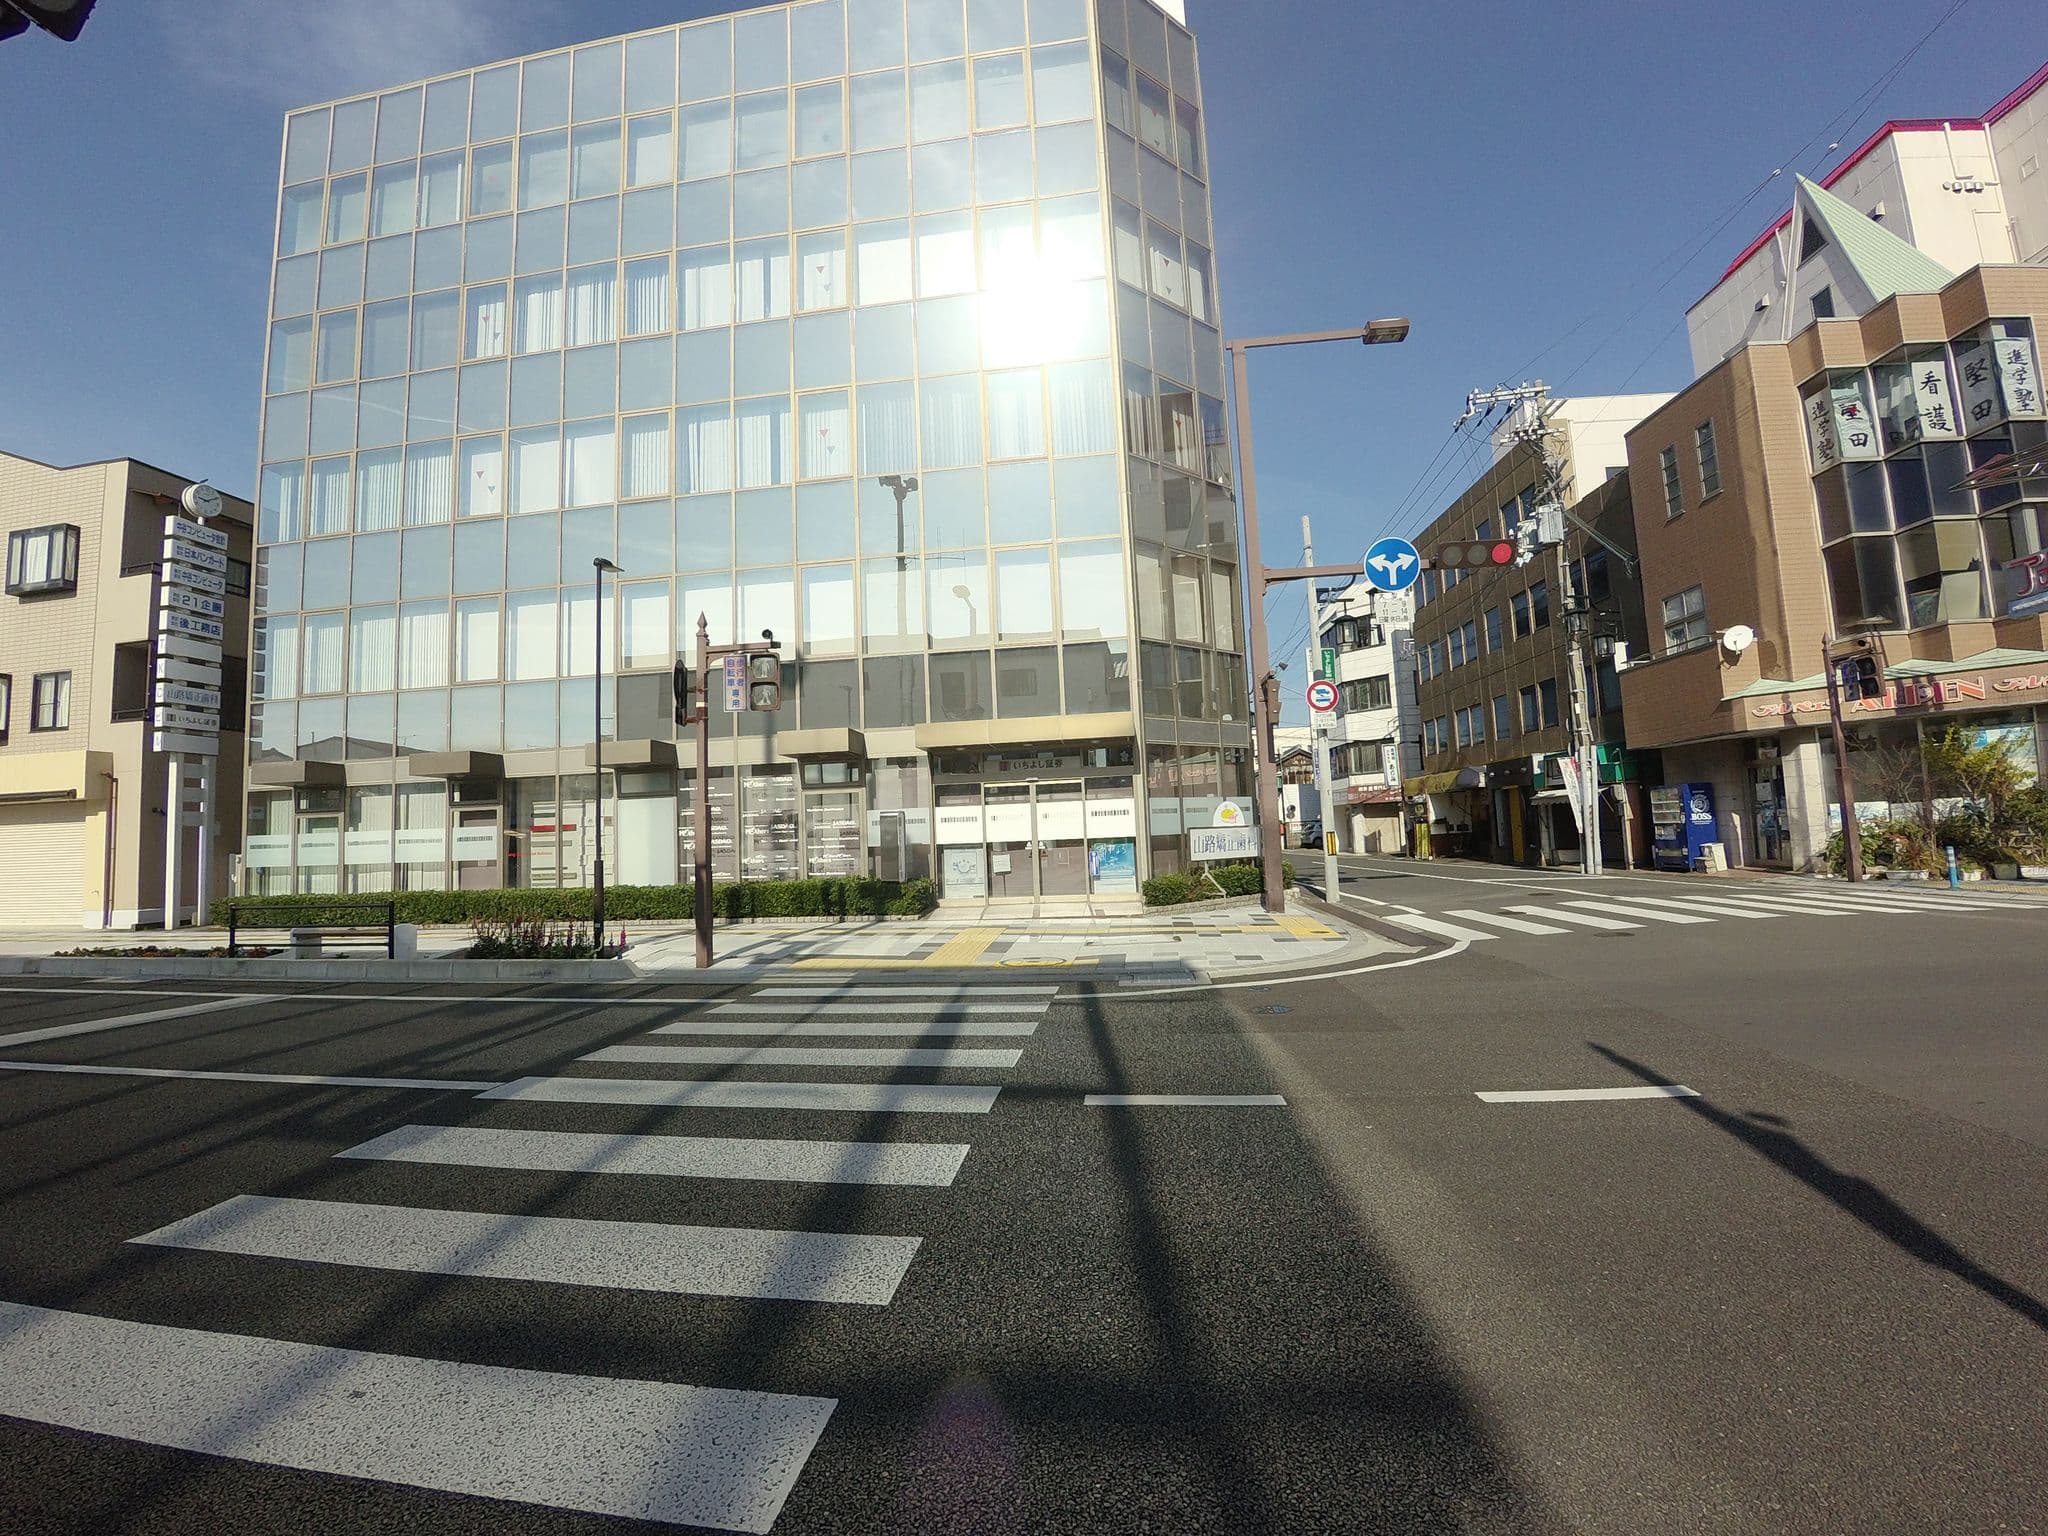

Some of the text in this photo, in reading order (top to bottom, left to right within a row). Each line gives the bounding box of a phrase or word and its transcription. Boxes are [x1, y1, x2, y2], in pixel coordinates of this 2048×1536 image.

[2008, 349, 2036, 413] 進学塾
[1919, 370, 1953, 433] 看護
[1013, 759, 1063, 770] いちよし証券
[1691, 812, 1712, 821] BOSS
